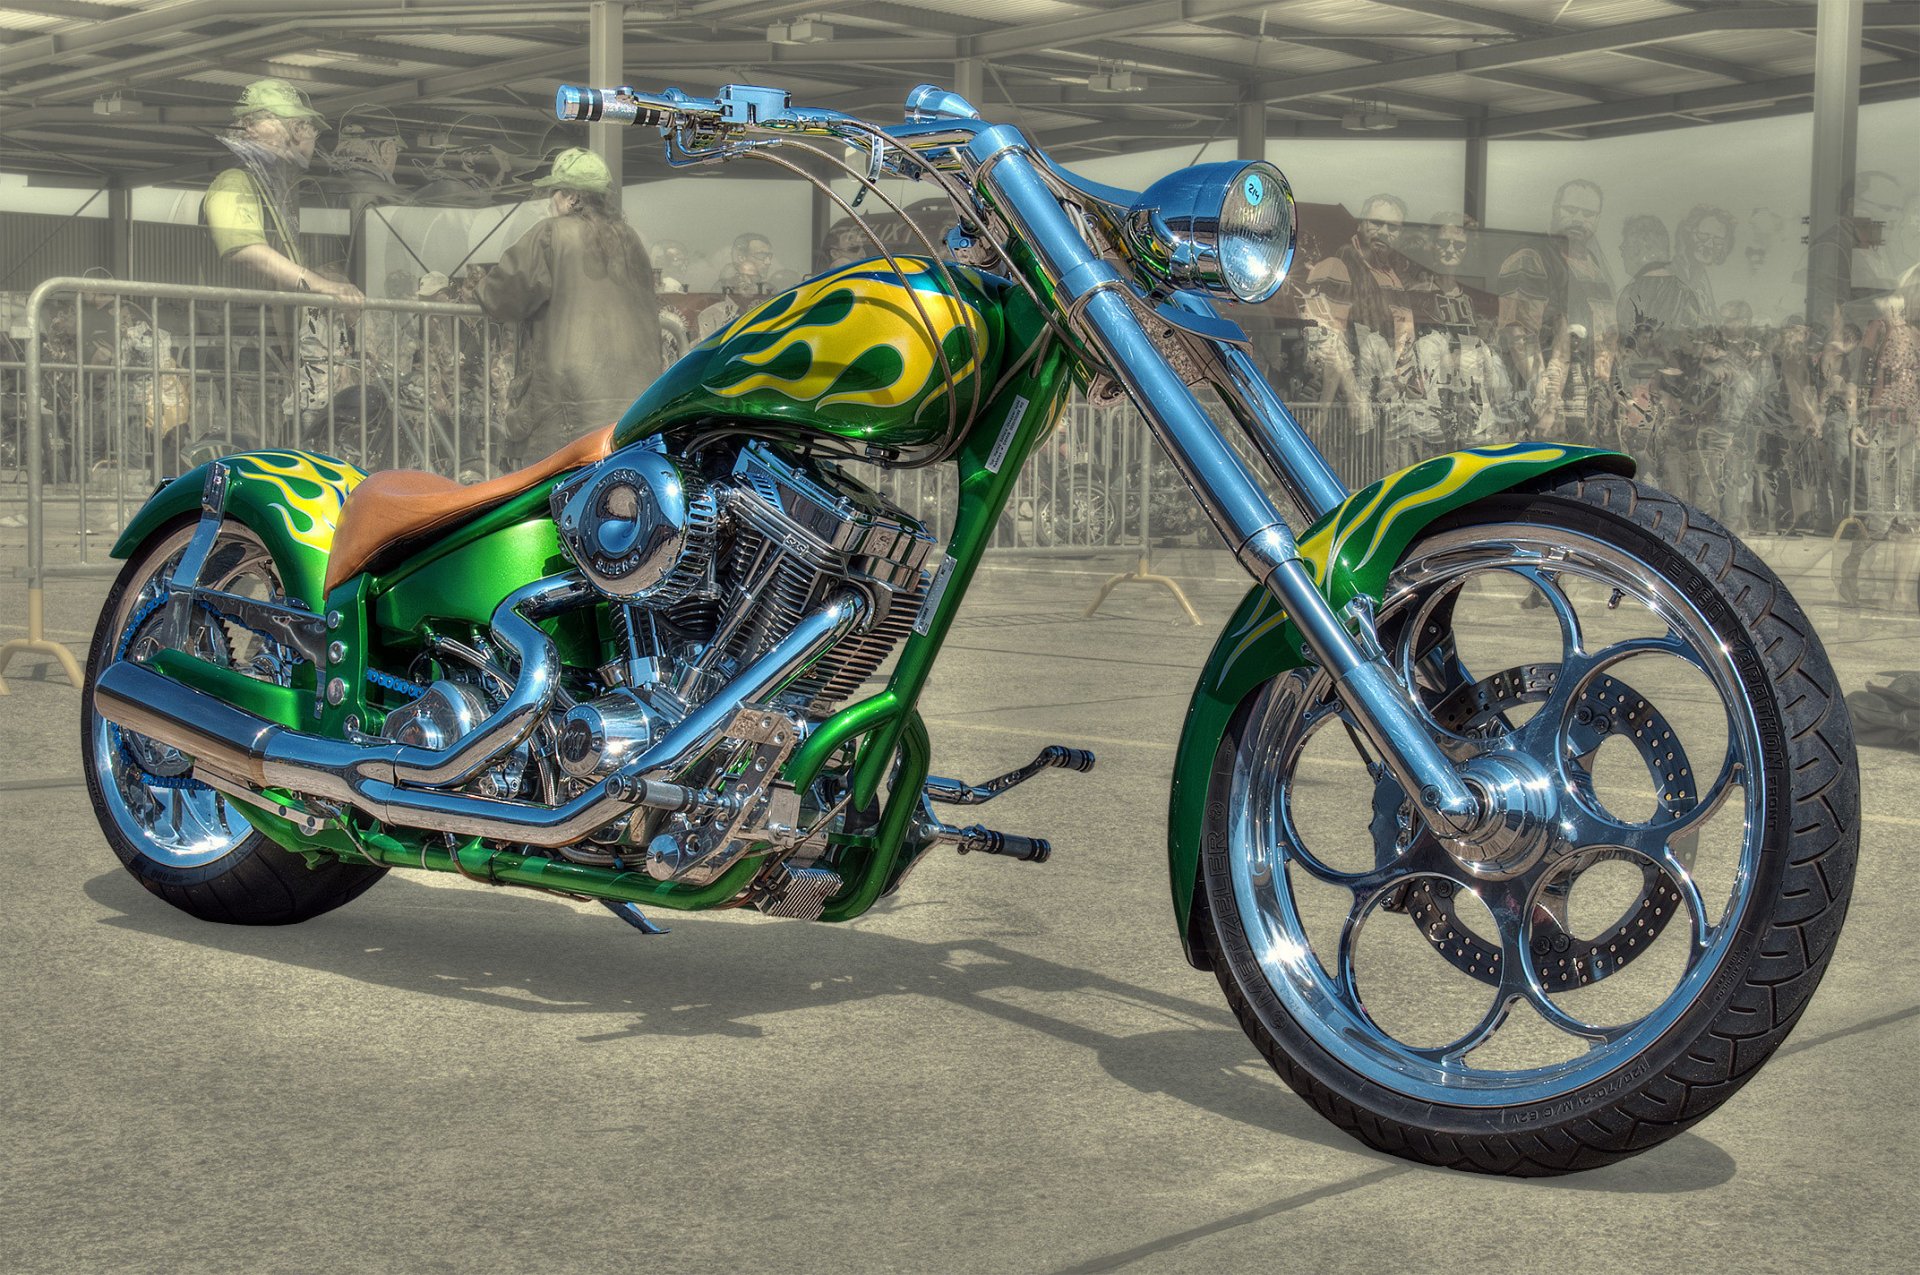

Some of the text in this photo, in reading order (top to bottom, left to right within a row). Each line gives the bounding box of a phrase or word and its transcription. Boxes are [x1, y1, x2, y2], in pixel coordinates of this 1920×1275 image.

[613, 470, 636, 481] S&S
[785, 536, 808, 554] S&S
[595, 559, 629, 575] SUPER
[1685, 575, 1725, 624] 880
[1723, 627, 1784, 771] MARATHON
[1767, 776, 1778, 831] FRONT
[1207, 831, 1272, 1009] METZELER
